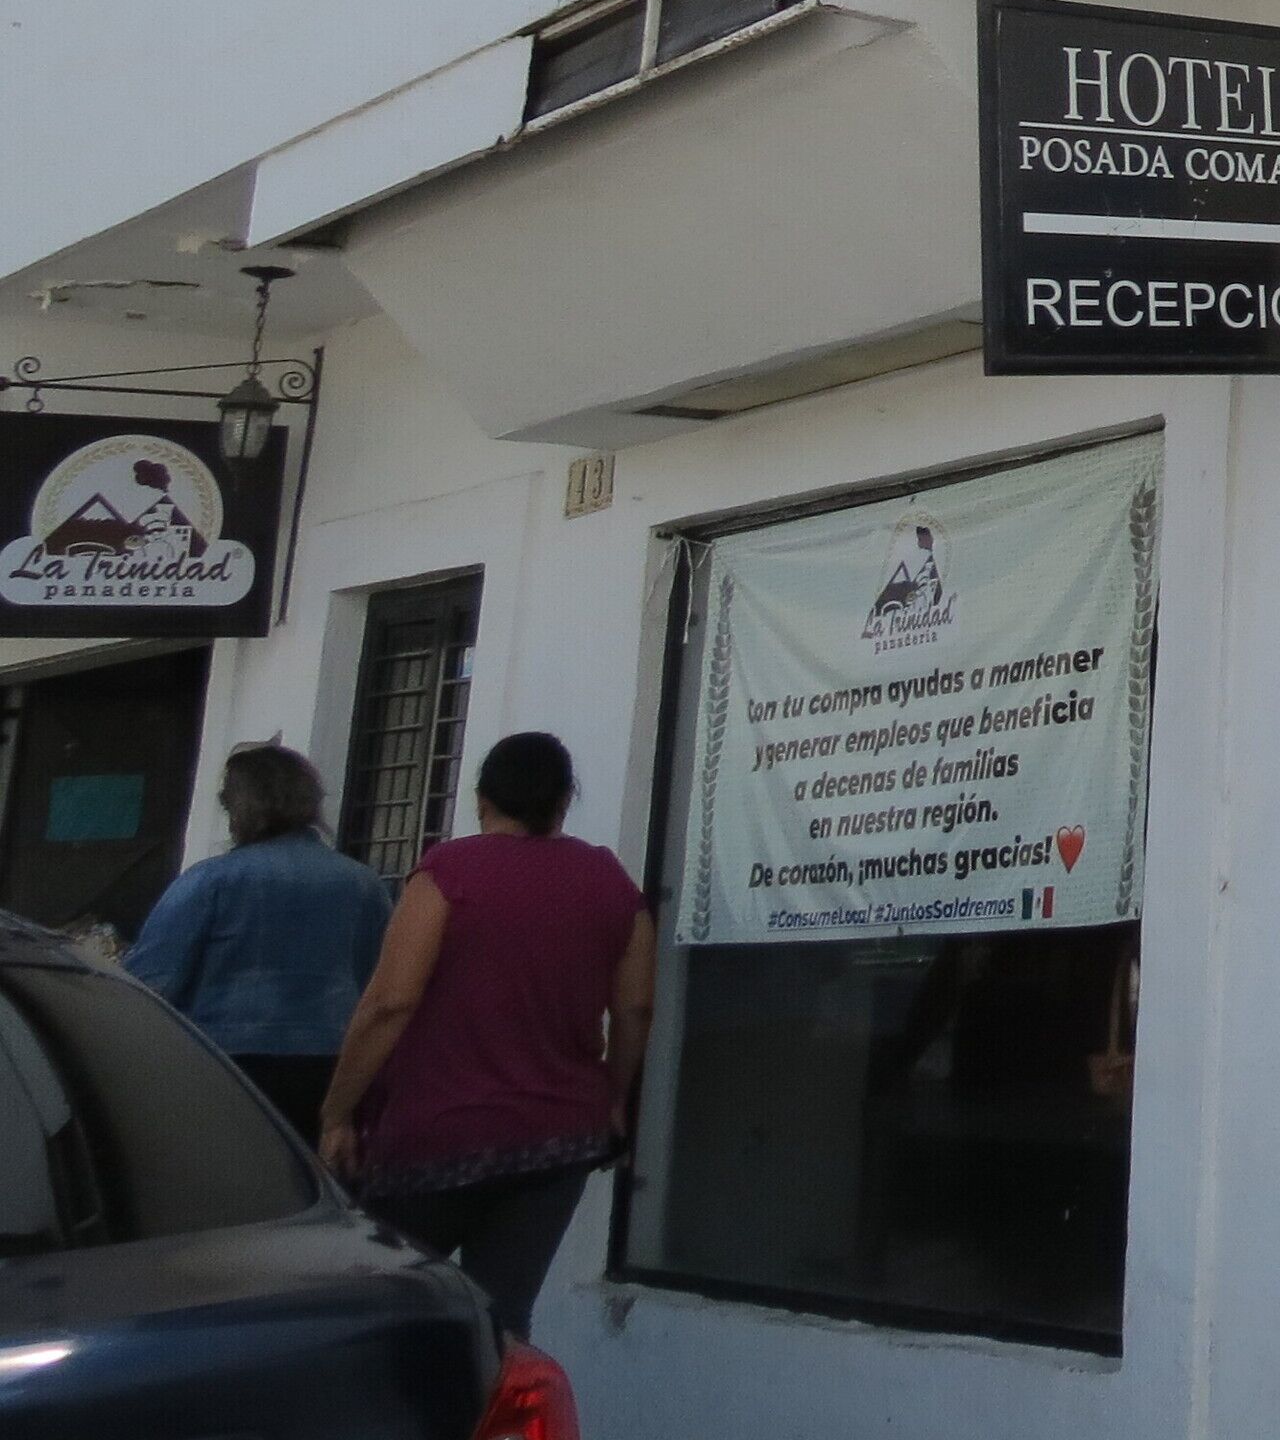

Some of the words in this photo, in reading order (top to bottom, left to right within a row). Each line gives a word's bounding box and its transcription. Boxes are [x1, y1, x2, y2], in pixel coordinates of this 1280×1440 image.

[1019, 136, 1175, 179] POSADA
[9, 543, 70, 581] La
[66, 542, 232, 582] Trinidad
[861, 607, 885, 639] La
[883, 595, 953, 637] Trinidad
[783, 695, 804, 718] tu
[809, 684, 882, 716] compra
[888, 668, 965, 708] ayudas
[970, 668, 984, 690] a
[989, 647, 1104, 687] mantener
[752, 745, 764, 772] y
[766, 734, 841, 770] generar
[845, 720, 932, 756] empleos
[937, 714, 974, 747] que
[978, 689, 1095, 734] beneficia
[794, 780, 807, 801] a
[812, 771, 896, 799] decenas
[902, 760, 927, 788] de
[932, 746, 1019, 785] familias
[809, 817, 832, 839] en
[837, 805, 917, 836] nuestra
[922, 793, 998, 833] región.
[749, 862, 773, 888] De
[778, 854, 853, 888] corazón,
[858, 847, 948, 886] ¡muchas
[954, 835, 1053, 880] gracias!
[768, 904, 872, 928] #ConsumeLocal
[874, 896, 1015, 923] #JuntosSaldremos
